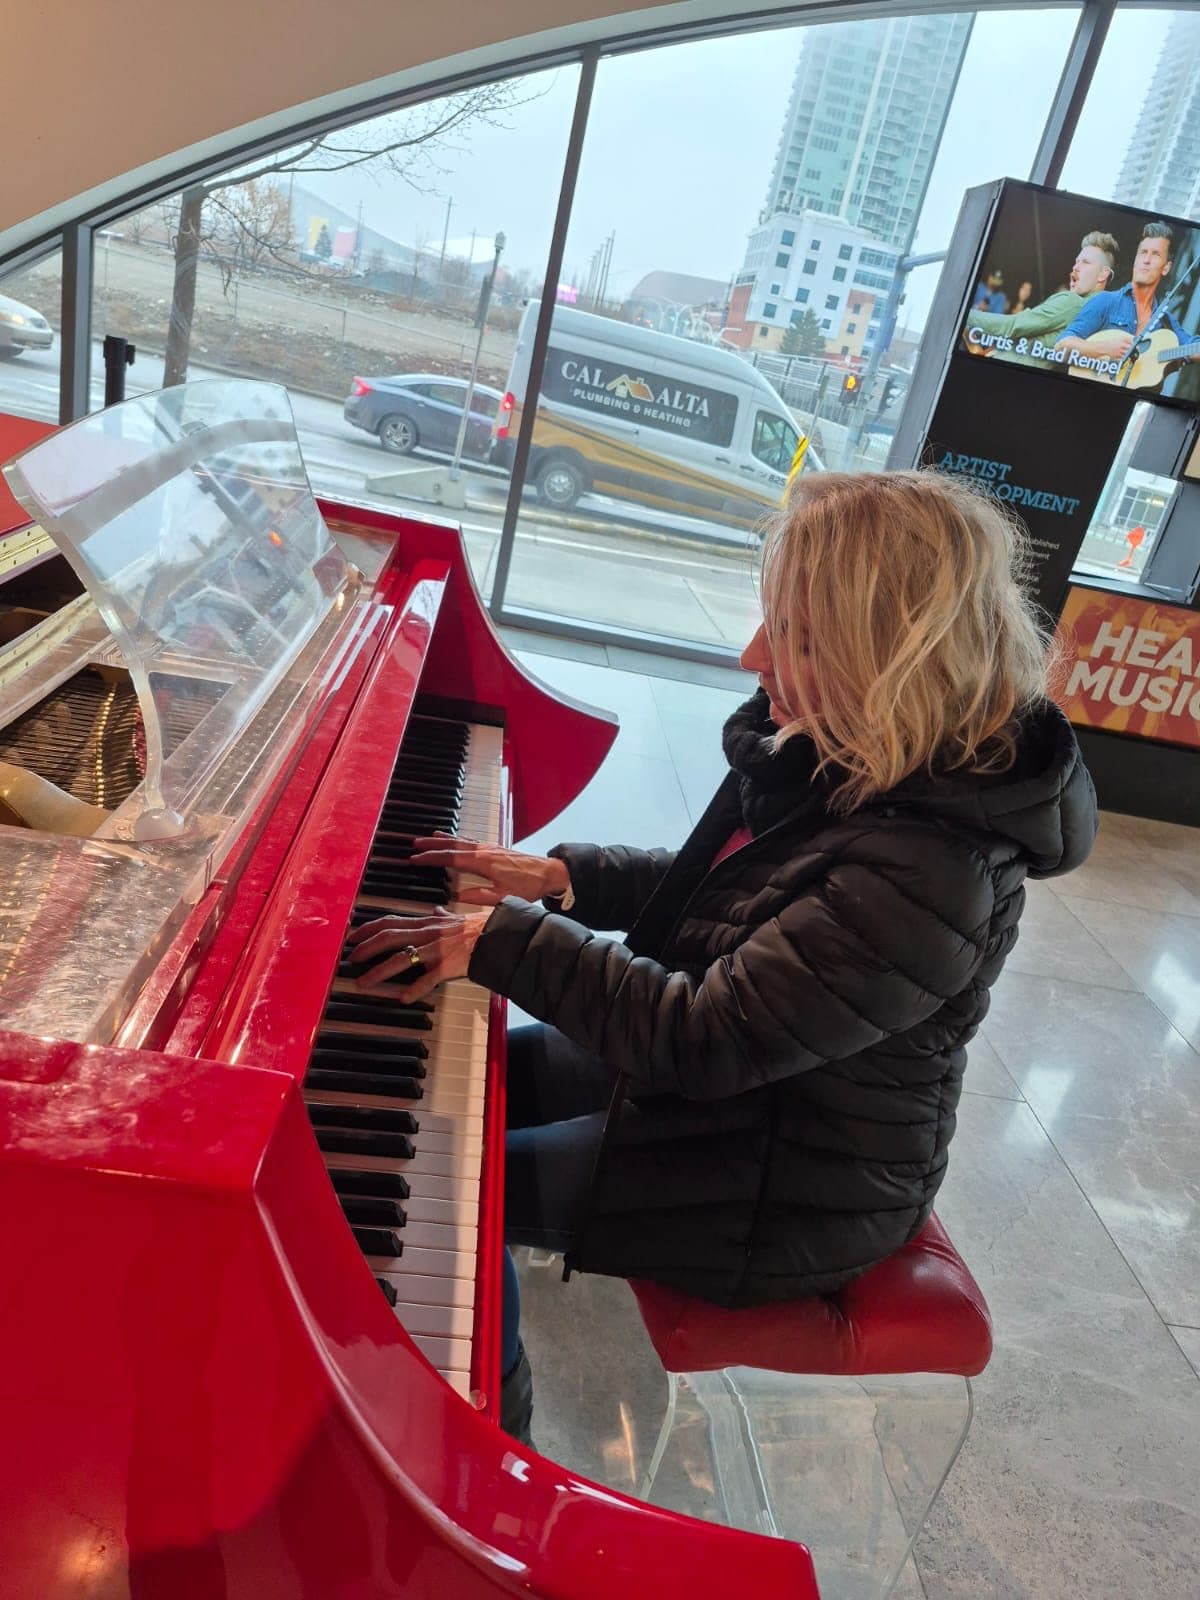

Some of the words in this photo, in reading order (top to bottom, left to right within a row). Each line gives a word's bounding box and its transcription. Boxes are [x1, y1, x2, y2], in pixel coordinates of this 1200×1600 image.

[968, 327, 1013, 351] Curtis
[1015, 337, 1029, 354] &
[1031, 341, 1066, 363] Brad
[1068, 349, 1123, 376] Rempel
[561, 361, 605, 388] CAL
[656, 387, 710, 418] ALTA
[573, 388, 630, 410] PLUMBING
[633, 404, 642, 414] &
[643, 407, 692, 428] HEATING
[939, 452, 1012, 480] ARTIST
[1091, 621, 1200, 678] HEA
